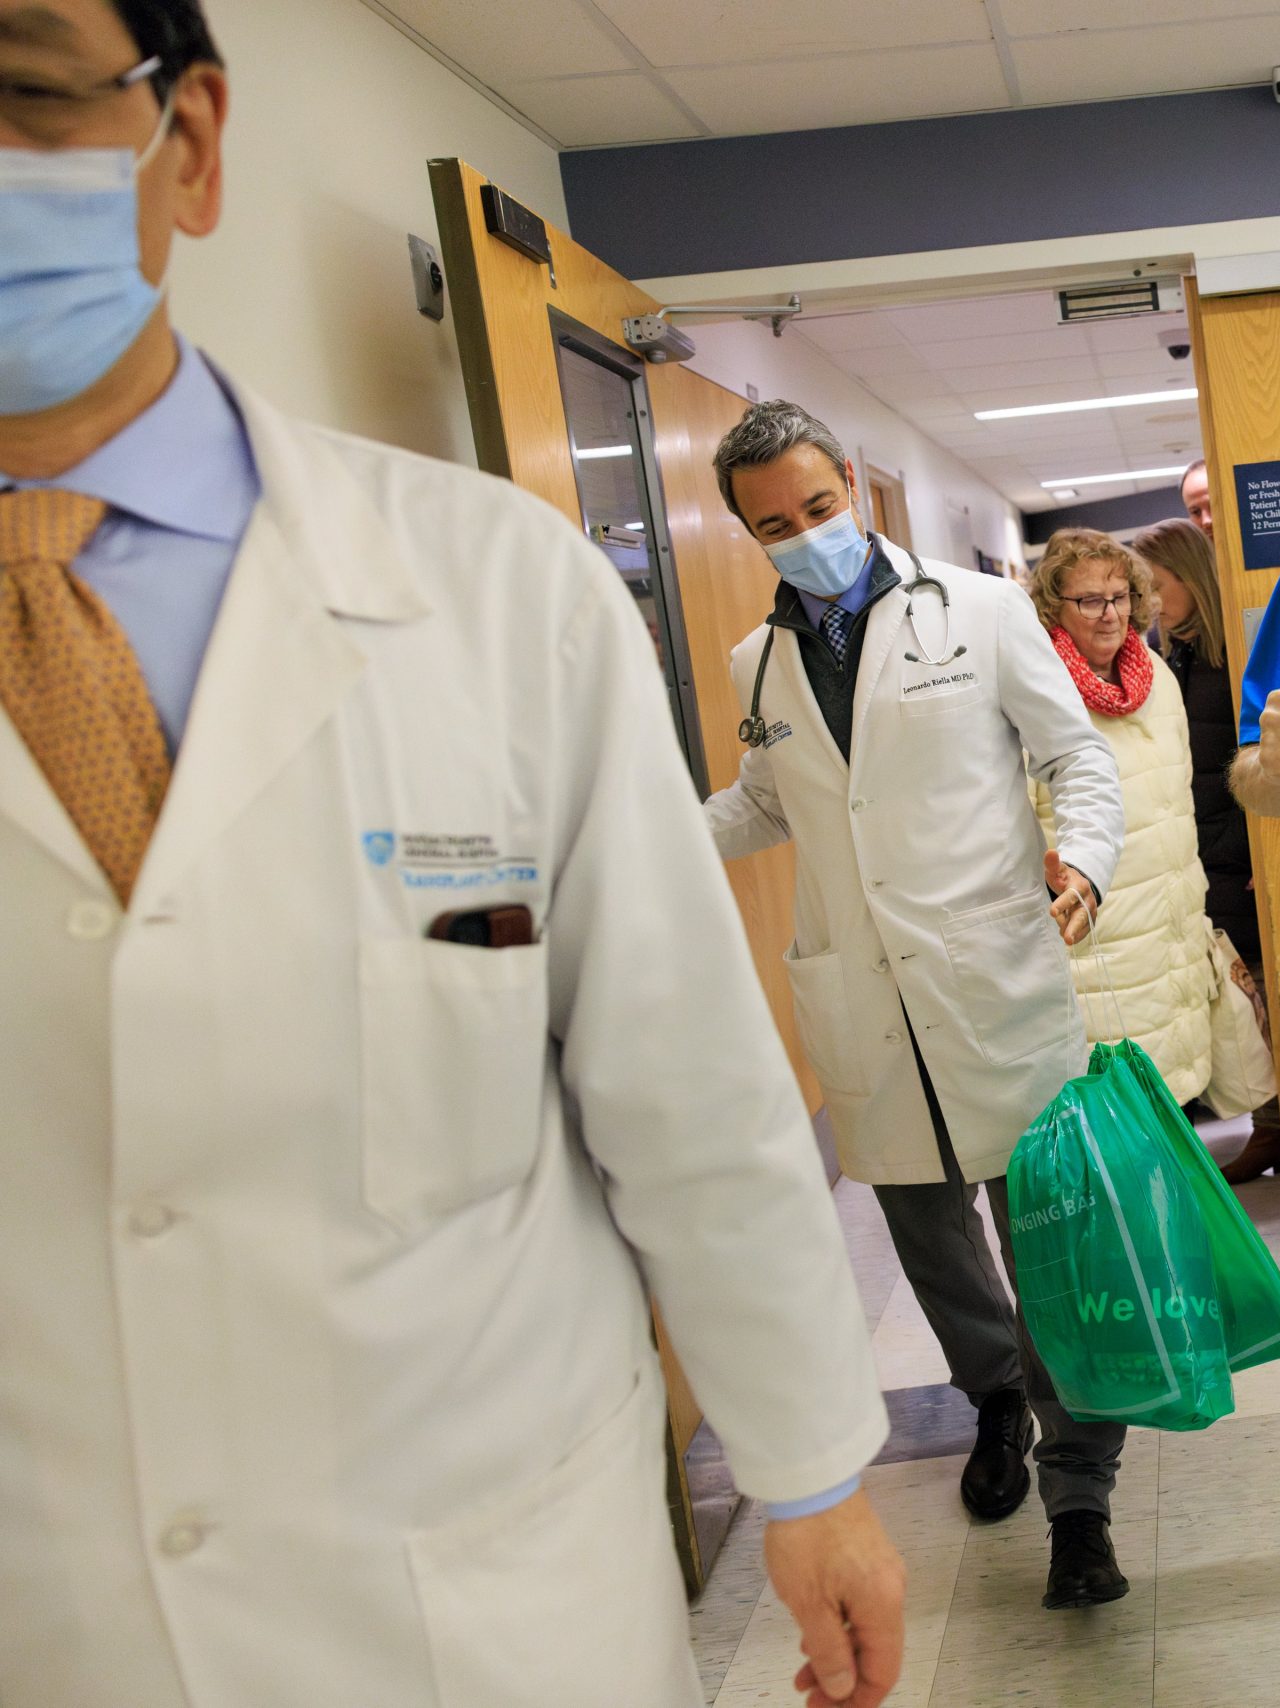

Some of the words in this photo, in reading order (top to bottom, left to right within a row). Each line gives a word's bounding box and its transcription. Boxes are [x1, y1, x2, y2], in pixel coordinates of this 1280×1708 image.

[1248, 481, 1260, 490] No
[1259, 490, 1280, 499] Fresh
[1250, 501, 1277, 510] Patient
[1251, 511, 1263, 520] No
[1252, 521, 1262, 530] 12
[902, 681, 931, 694] Leonardo
[931, 676, 951, 687] Riella
[951, 674, 962, 682] MD
[962, 672, 975, 680] PhD
[1076, 1291, 1136, 1324] We
[1152, 1287, 1220, 1321] love
